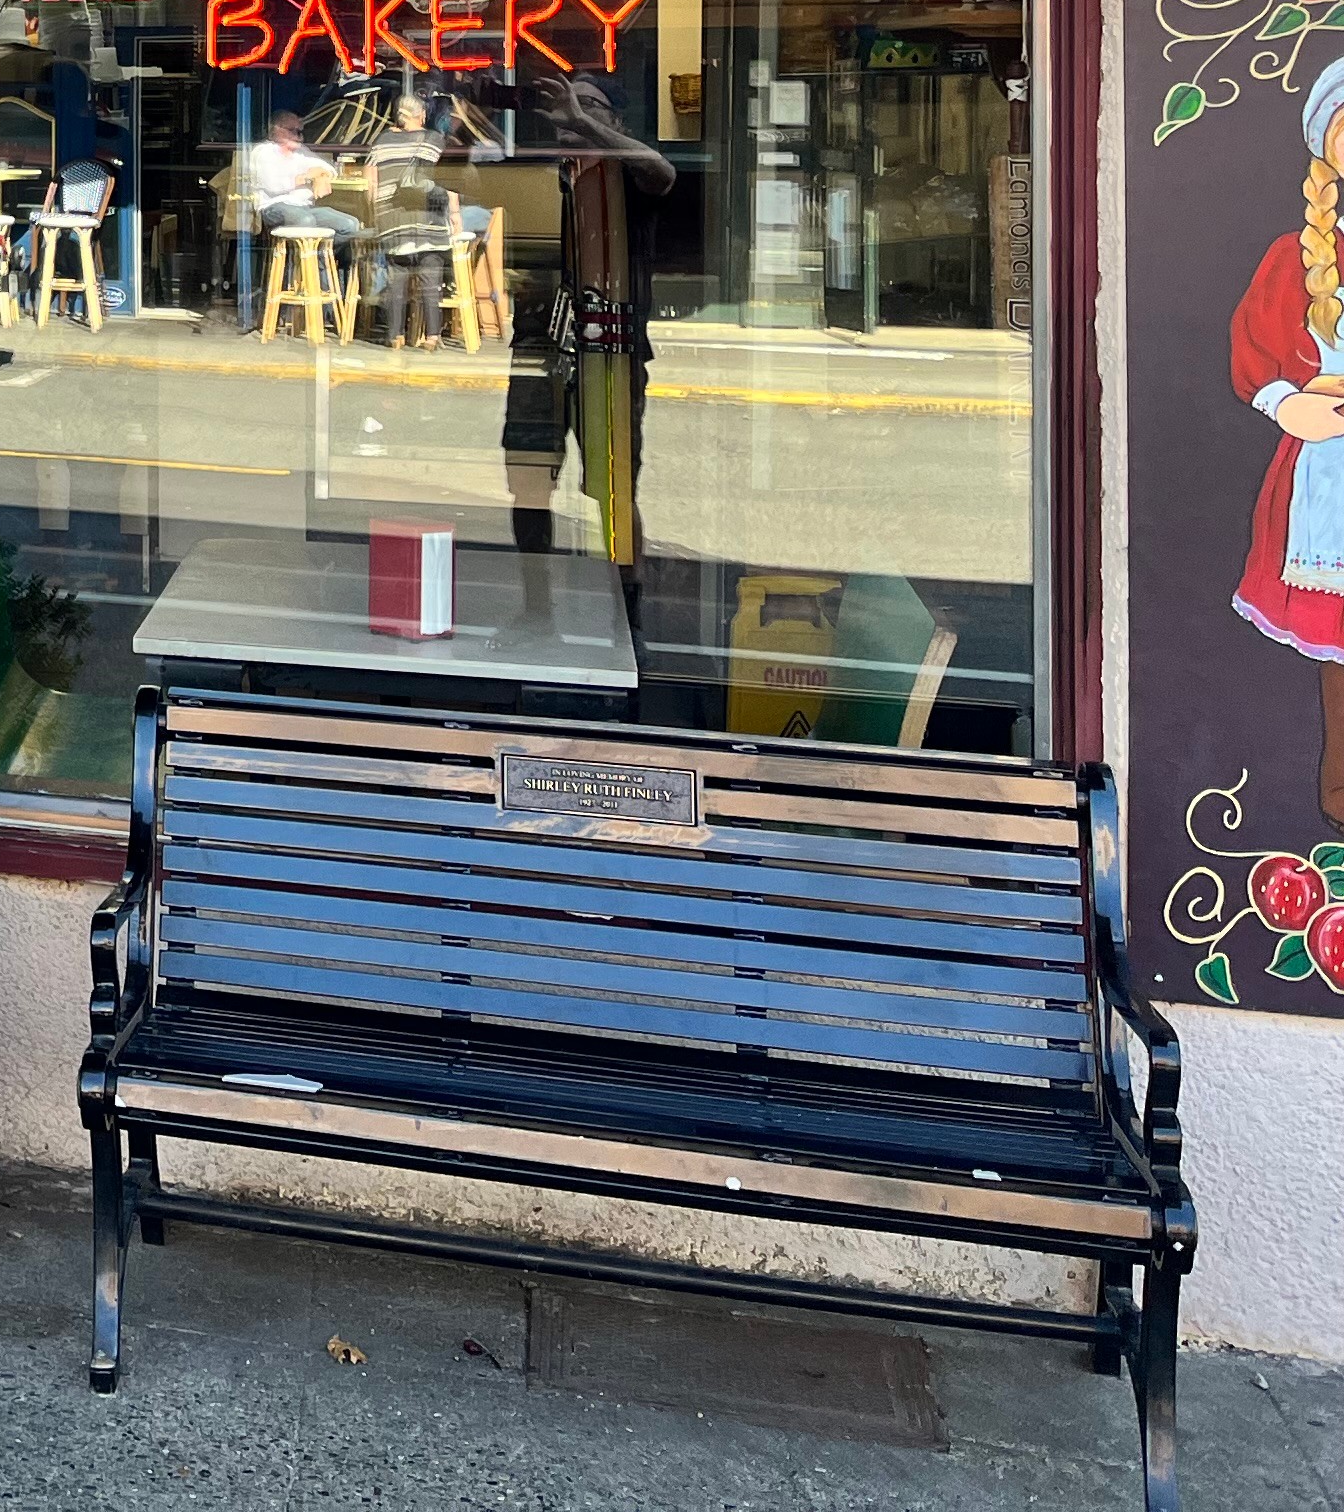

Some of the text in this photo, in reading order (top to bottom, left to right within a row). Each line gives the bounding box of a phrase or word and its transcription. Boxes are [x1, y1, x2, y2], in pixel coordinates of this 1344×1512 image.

[763, 667, 828, 688] CAUTIO
[551, 768, 645, 784] IN LOVING MEMORY OF
[523, 778, 673, 802] SHIRLEY RUTH FINLEY
